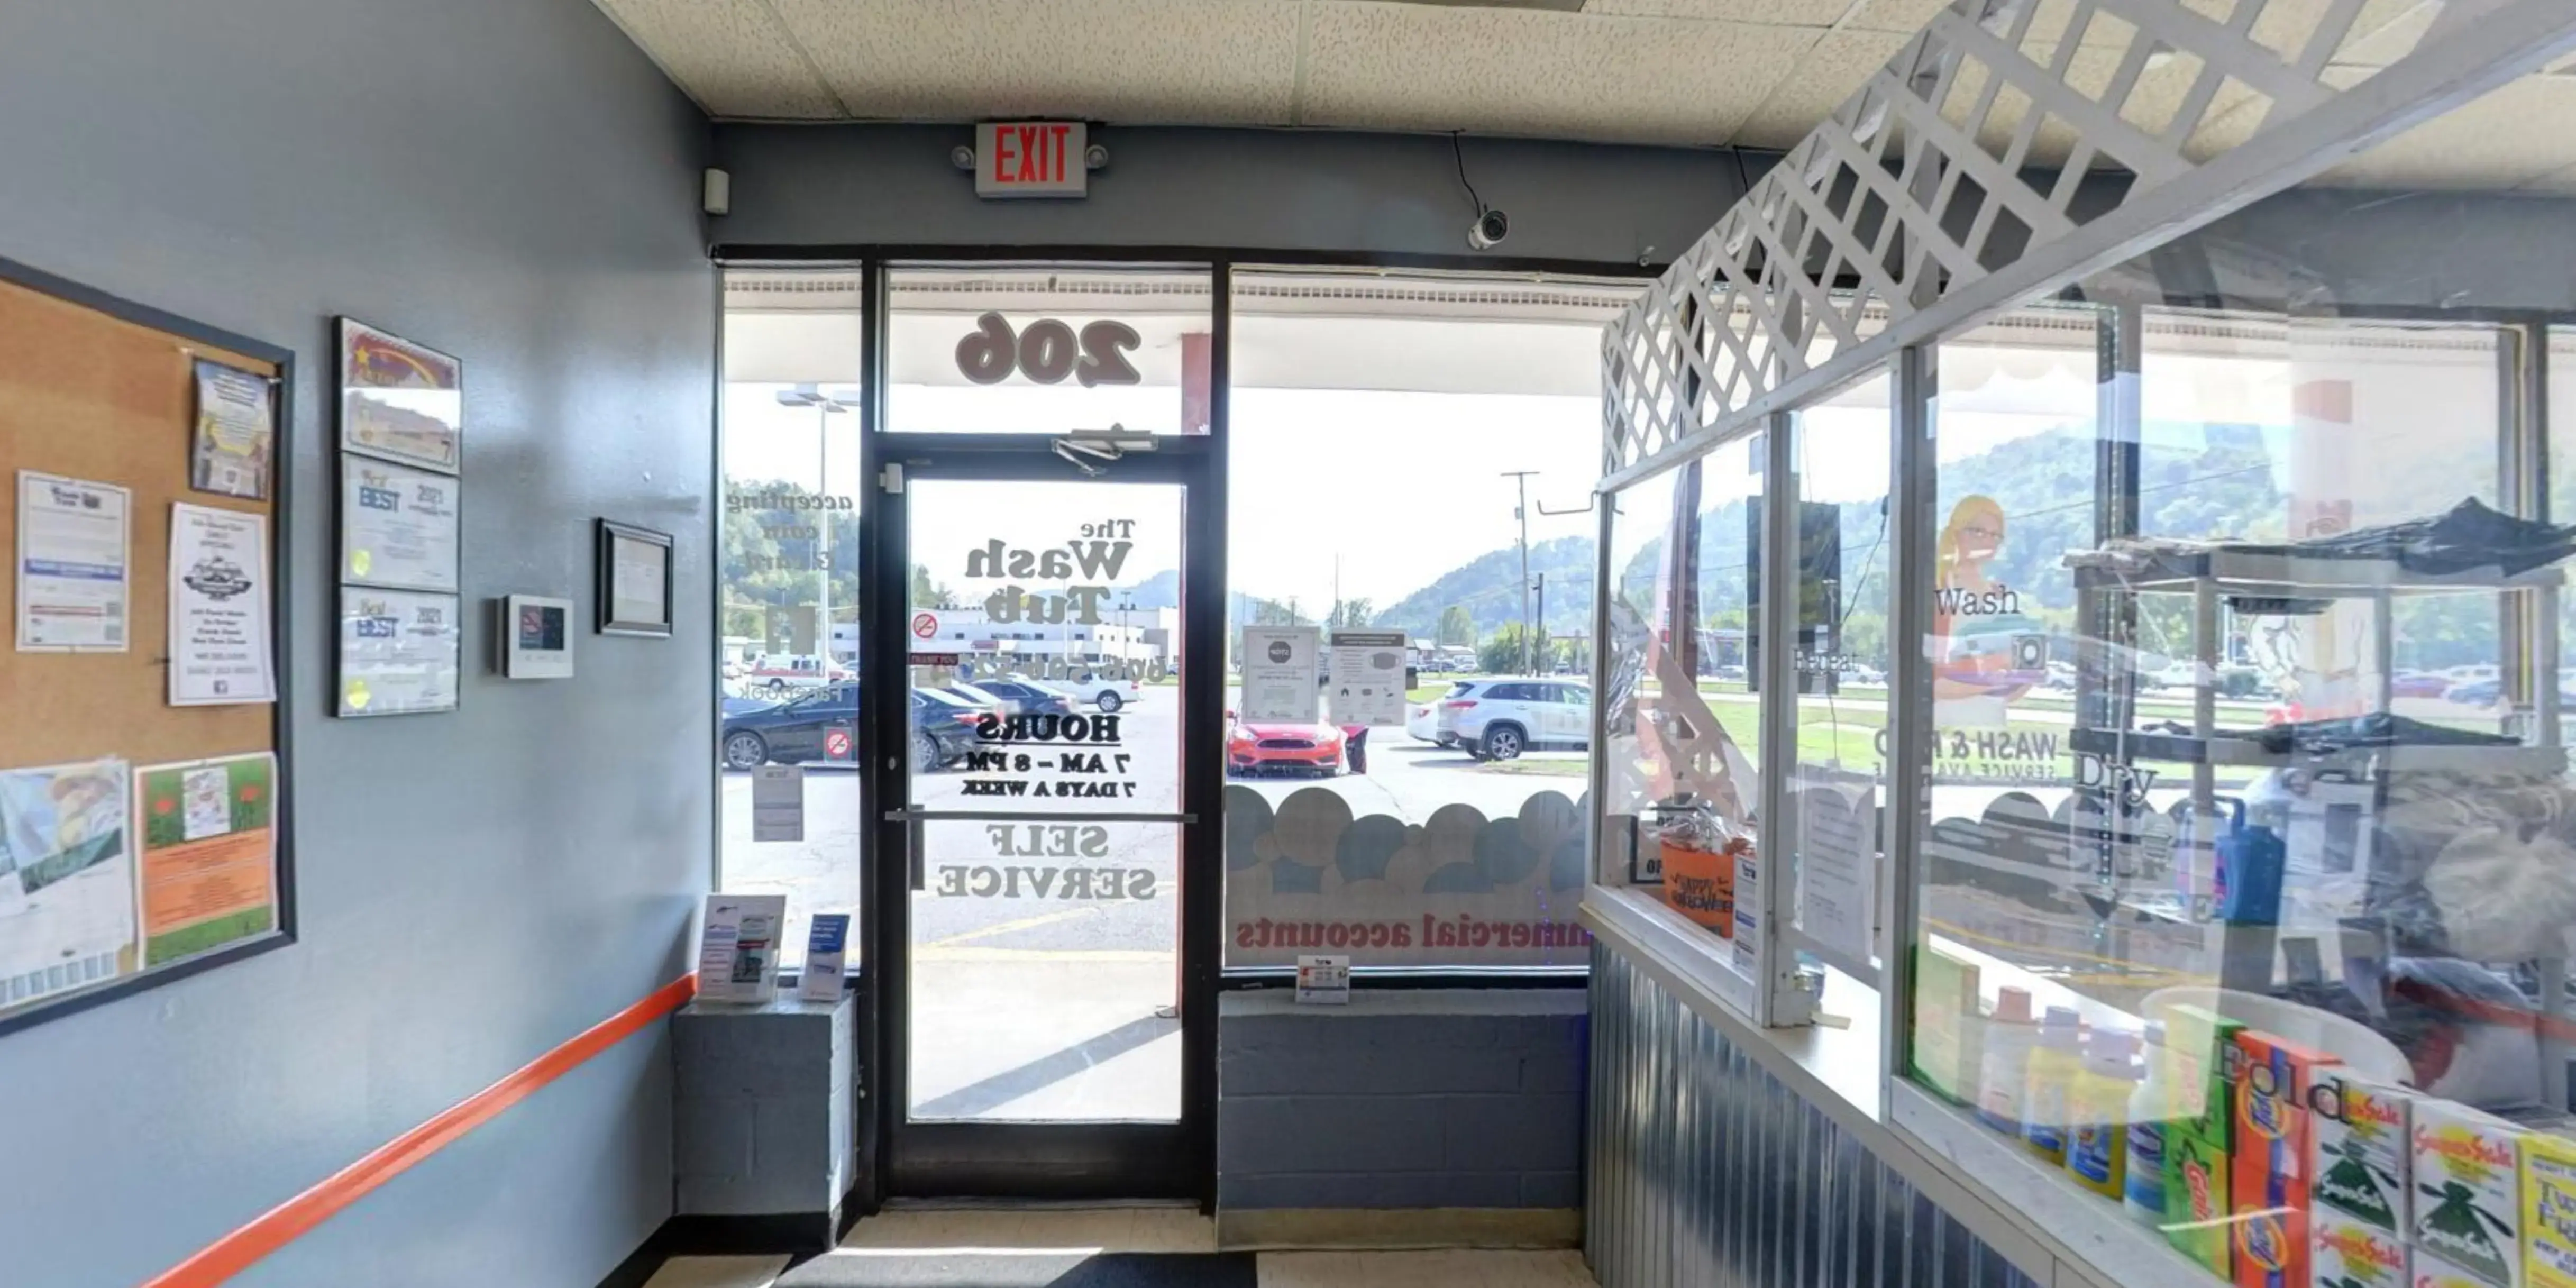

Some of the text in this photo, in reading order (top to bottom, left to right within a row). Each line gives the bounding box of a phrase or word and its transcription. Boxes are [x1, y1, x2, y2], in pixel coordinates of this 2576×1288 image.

[995, 126, 1070, 182] EXIT
[1933, 585, 2021, 616] Wash
[2077, 753, 2160, 806] Dry
